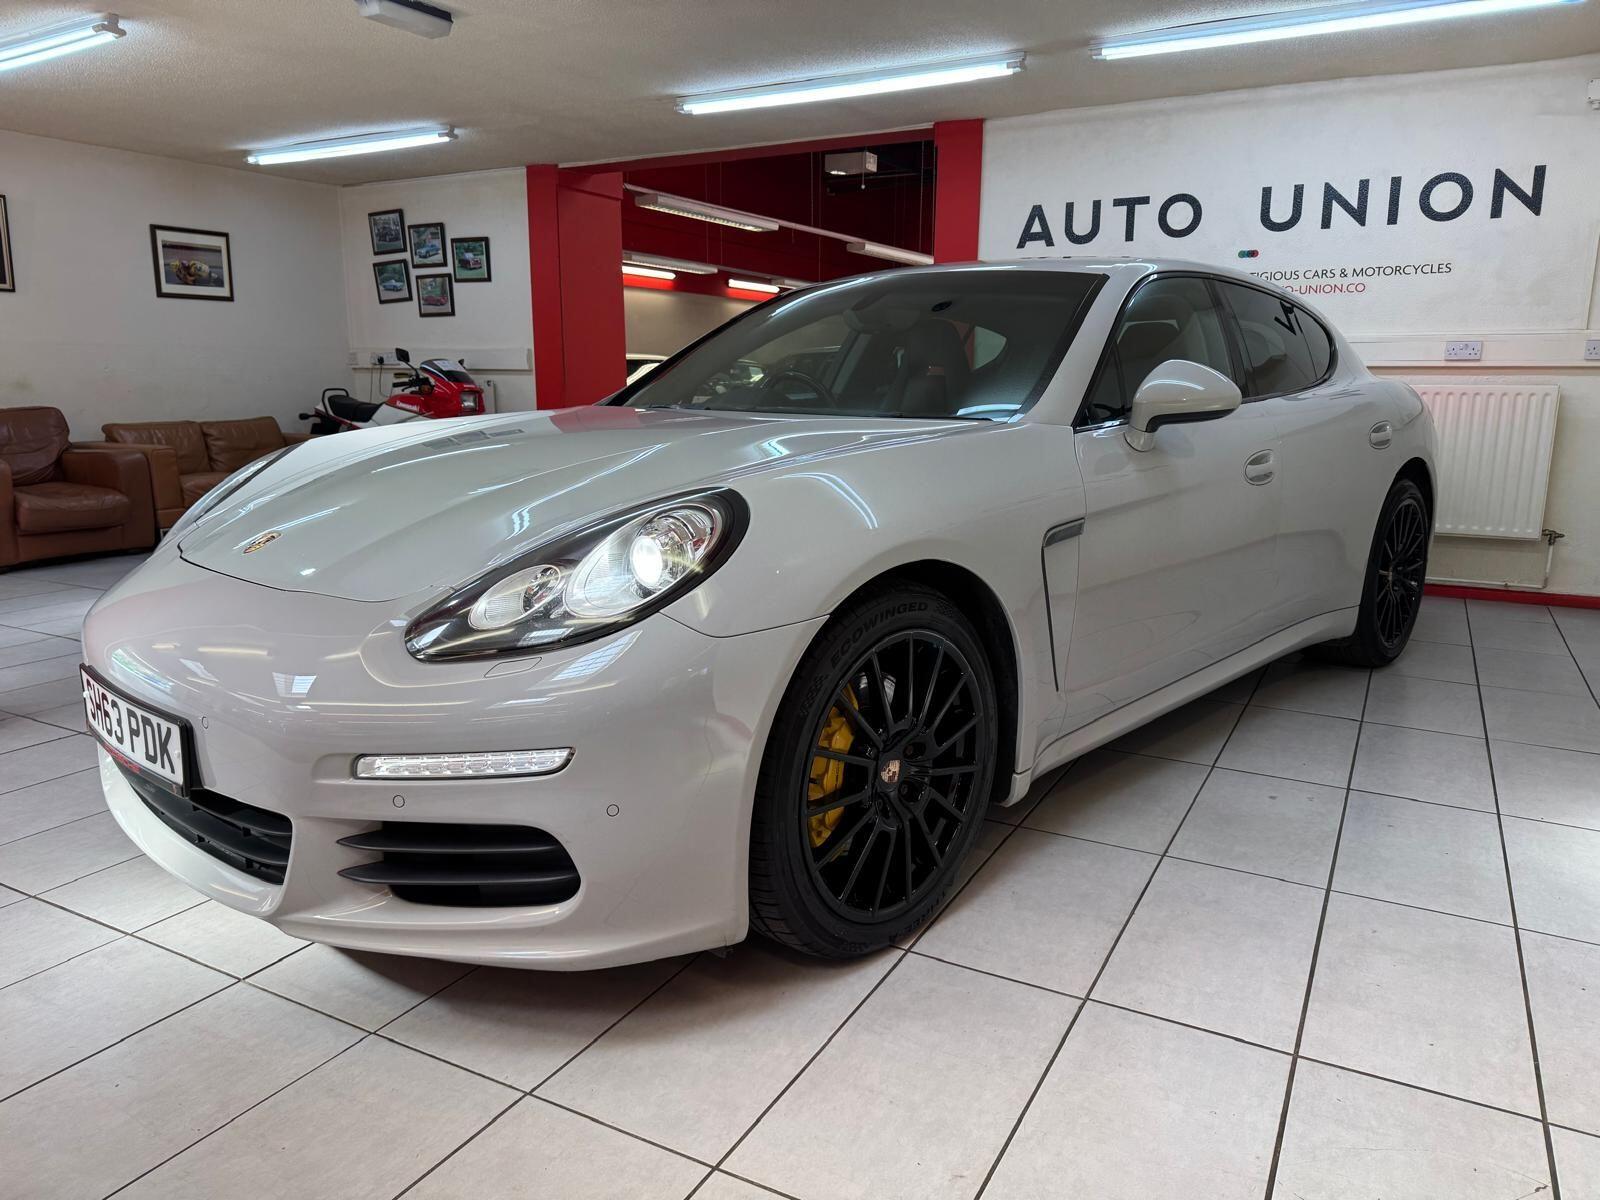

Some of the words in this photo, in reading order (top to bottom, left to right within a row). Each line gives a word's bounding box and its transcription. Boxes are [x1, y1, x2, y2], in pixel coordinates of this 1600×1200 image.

[1016, 193, 1203, 249] AUTO
[1259, 164, 1547, 232] UNION
[1303, 269, 1336, 280] CARS
[1339, 268, 1348, 278] &
[1351, 263, 1452, 277] MOTORCYCLES
[831, 602, 928, 667] ECOWINGED
[86, 680, 124, 746] SH63
[126, 707, 176, 775] PDK
